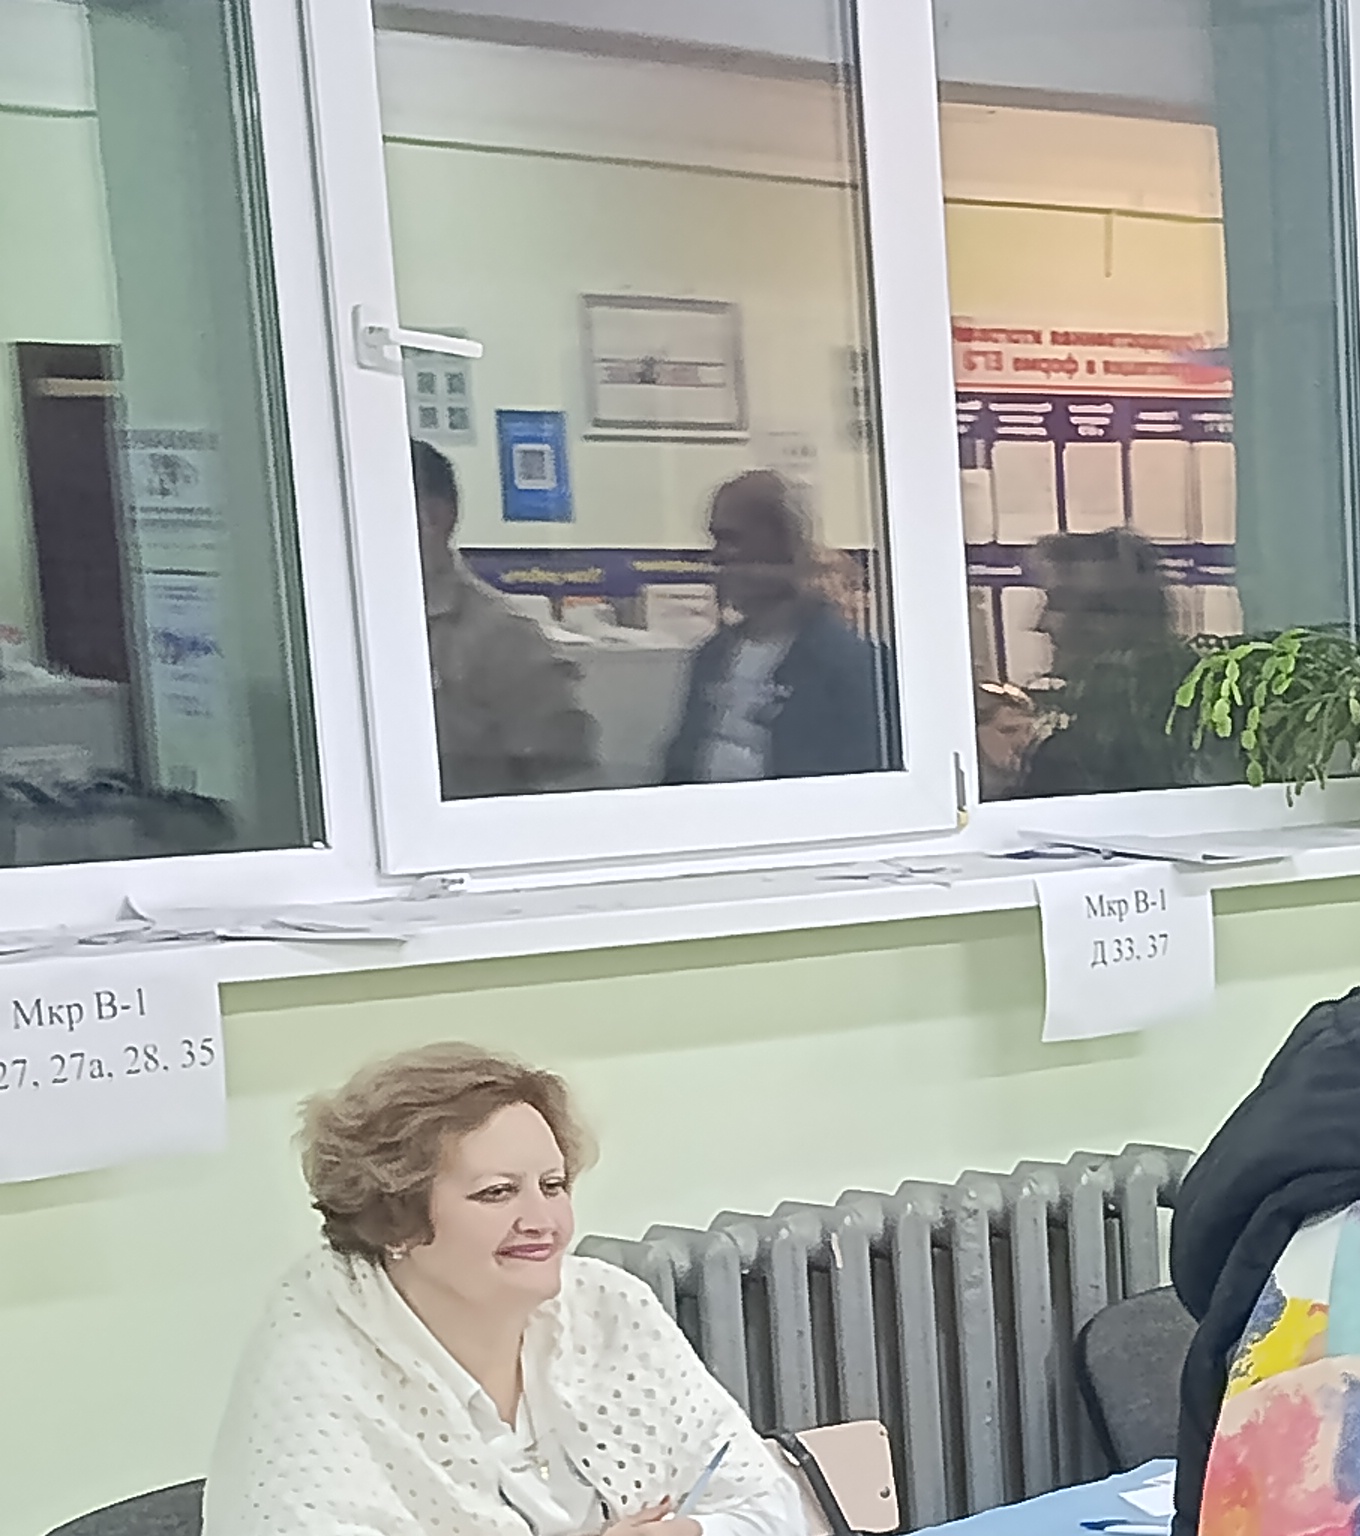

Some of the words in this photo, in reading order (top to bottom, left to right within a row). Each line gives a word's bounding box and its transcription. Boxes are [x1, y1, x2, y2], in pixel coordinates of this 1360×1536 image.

[1085, 894, 1129, 923] Мкр
[1134, 888, 1166, 914] В-1
[1091, 940, 1108, 969] Д
[1147, 933, 1168, 959] 37
[12, 998, 84, 1032] Мкр
[94, 987, 145, 1020] В-1
[181, 1037, 215, 1069] 35
